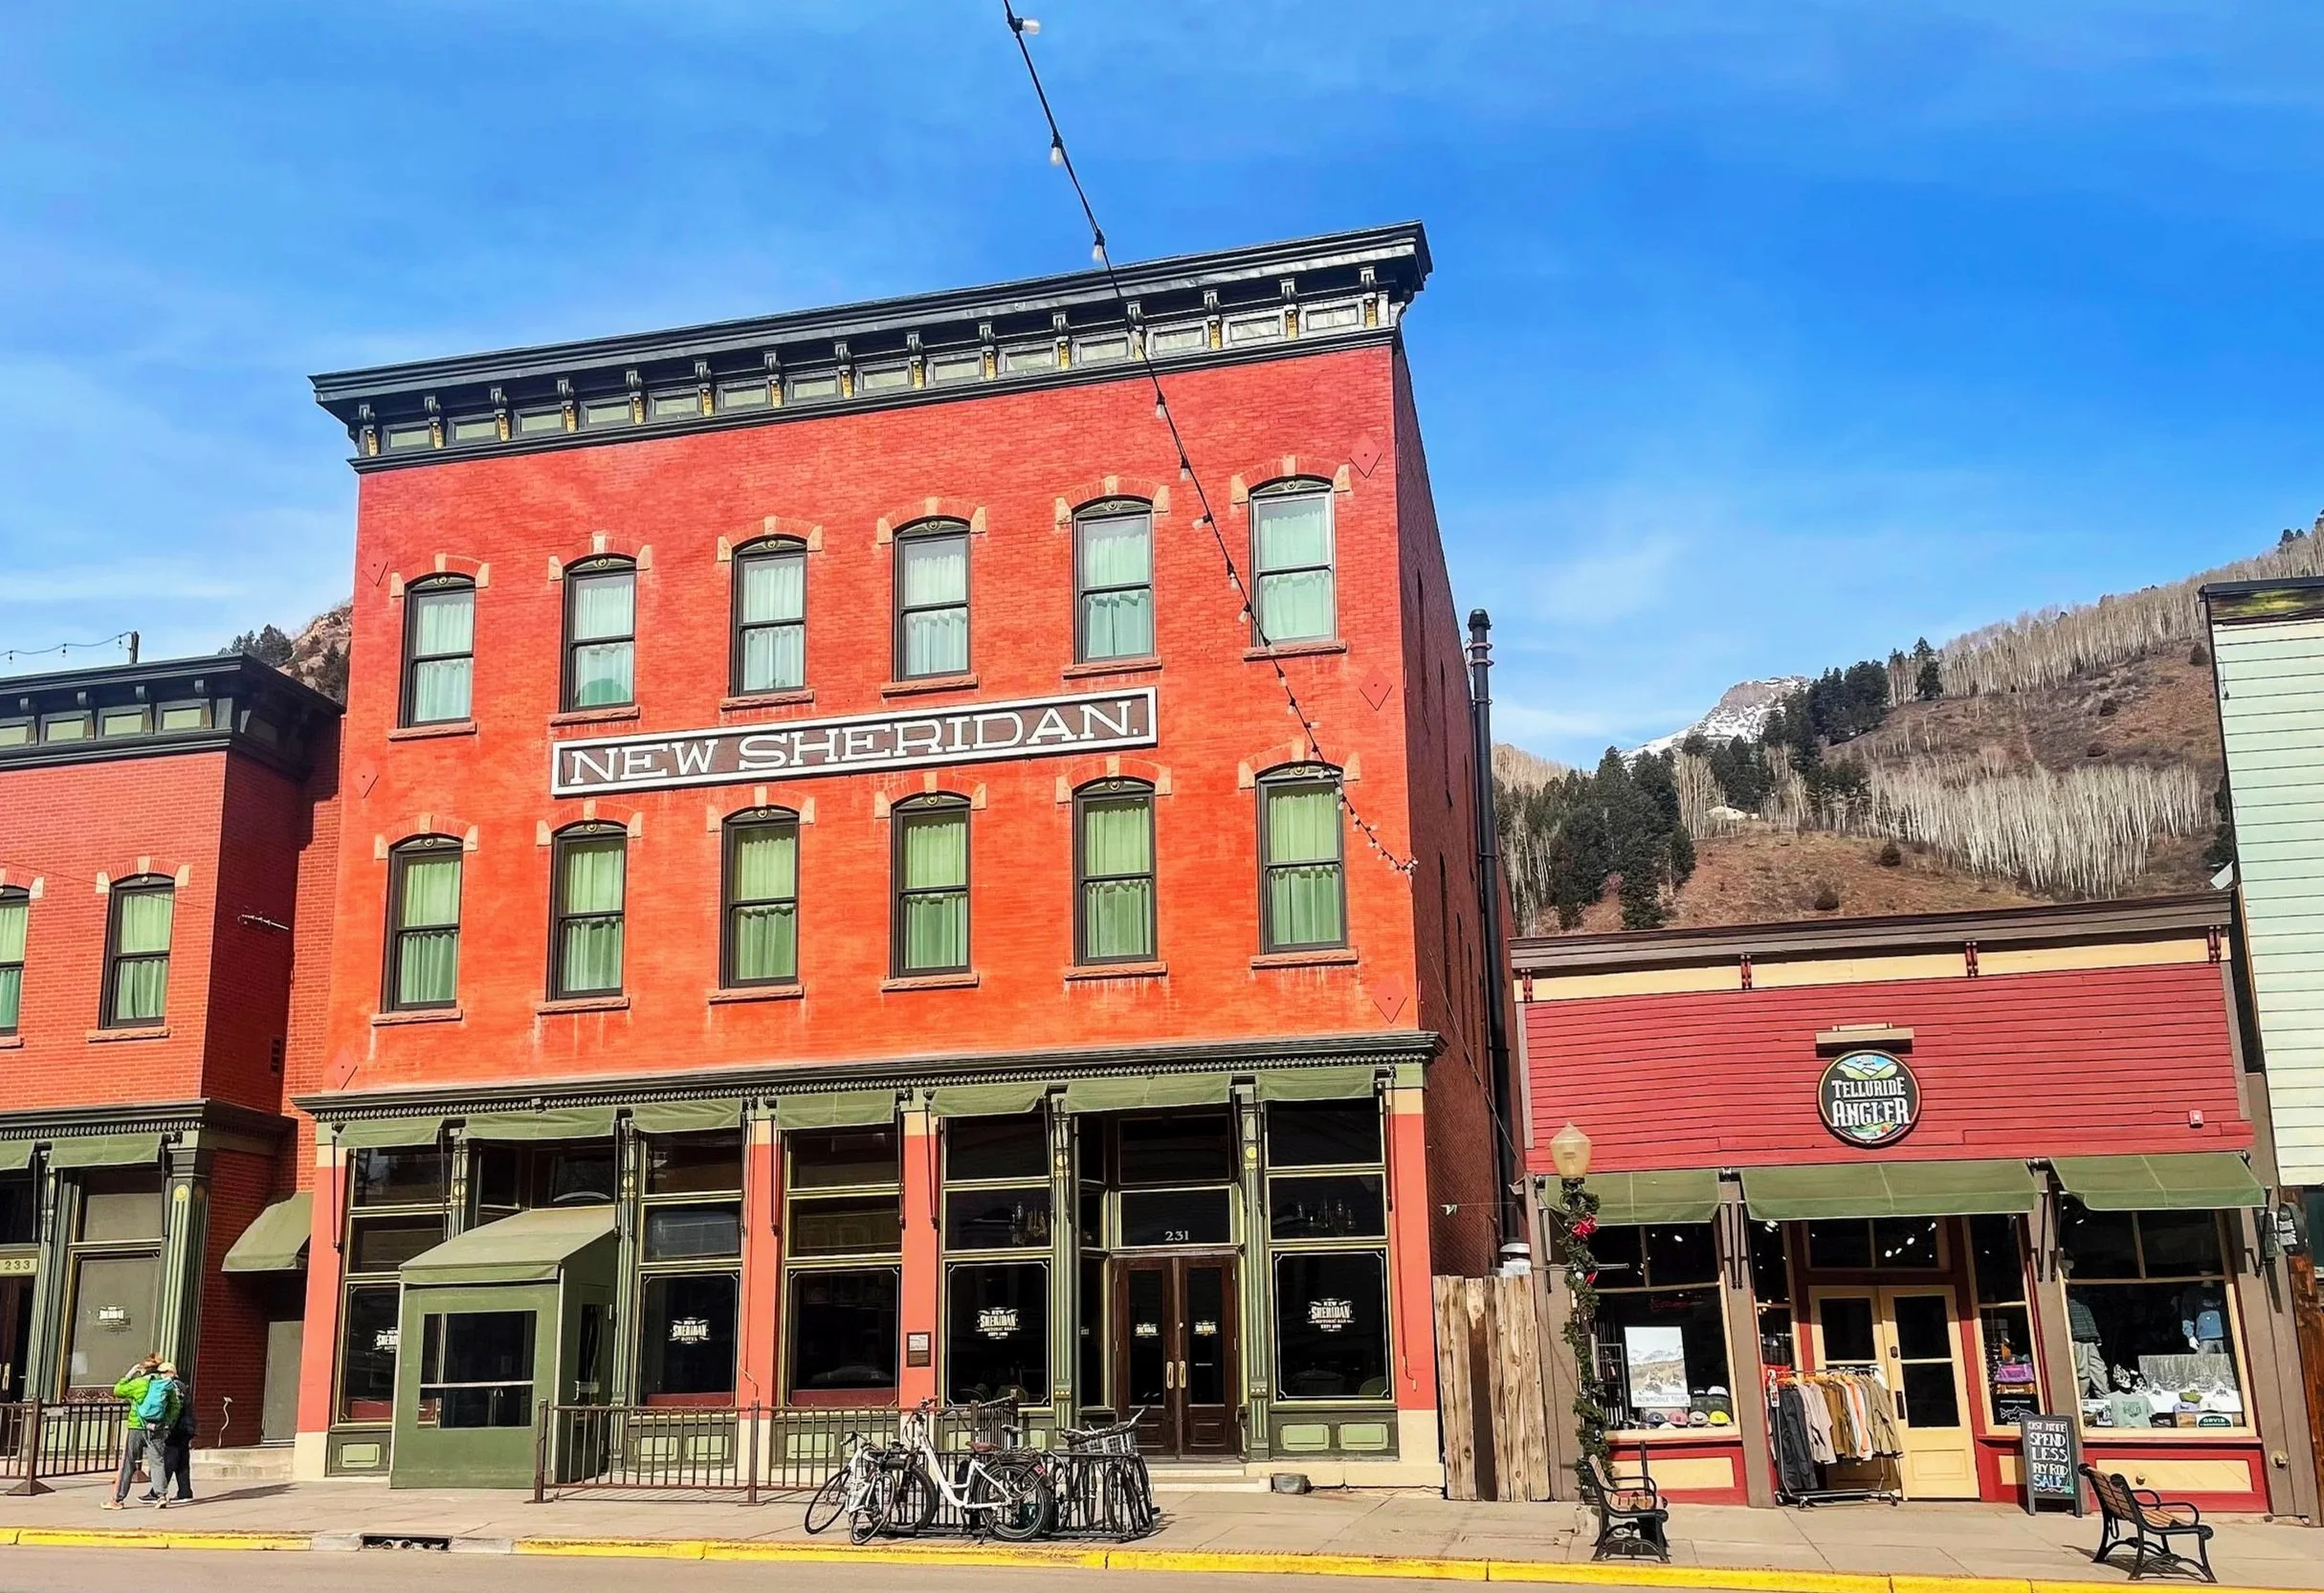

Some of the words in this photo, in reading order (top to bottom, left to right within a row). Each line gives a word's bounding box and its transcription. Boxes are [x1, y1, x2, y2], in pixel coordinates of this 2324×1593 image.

[569, 739, 719, 785] NEW
[1831, 1076, 1906, 1098] TELLURIDE
[1831, 1097, 1911, 1127] ANGLER
[1164, 1230, 1189, 1242] 231
[5, 1260, 31, 1271] 233
[1311, 1305, 1350, 1319] SHERIDAN
[980, 1314, 1016, 1328] SHERIDAN
[672, 1324, 707, 1338] SHERIDAN
[2028, 1432, 2067, 1448] SPEND
[2031, 1447, 2069, 1463] LESS
[2032, 1462, 2048, 1474] FLY
[2048, 1464, 2069, 1477] ROD
